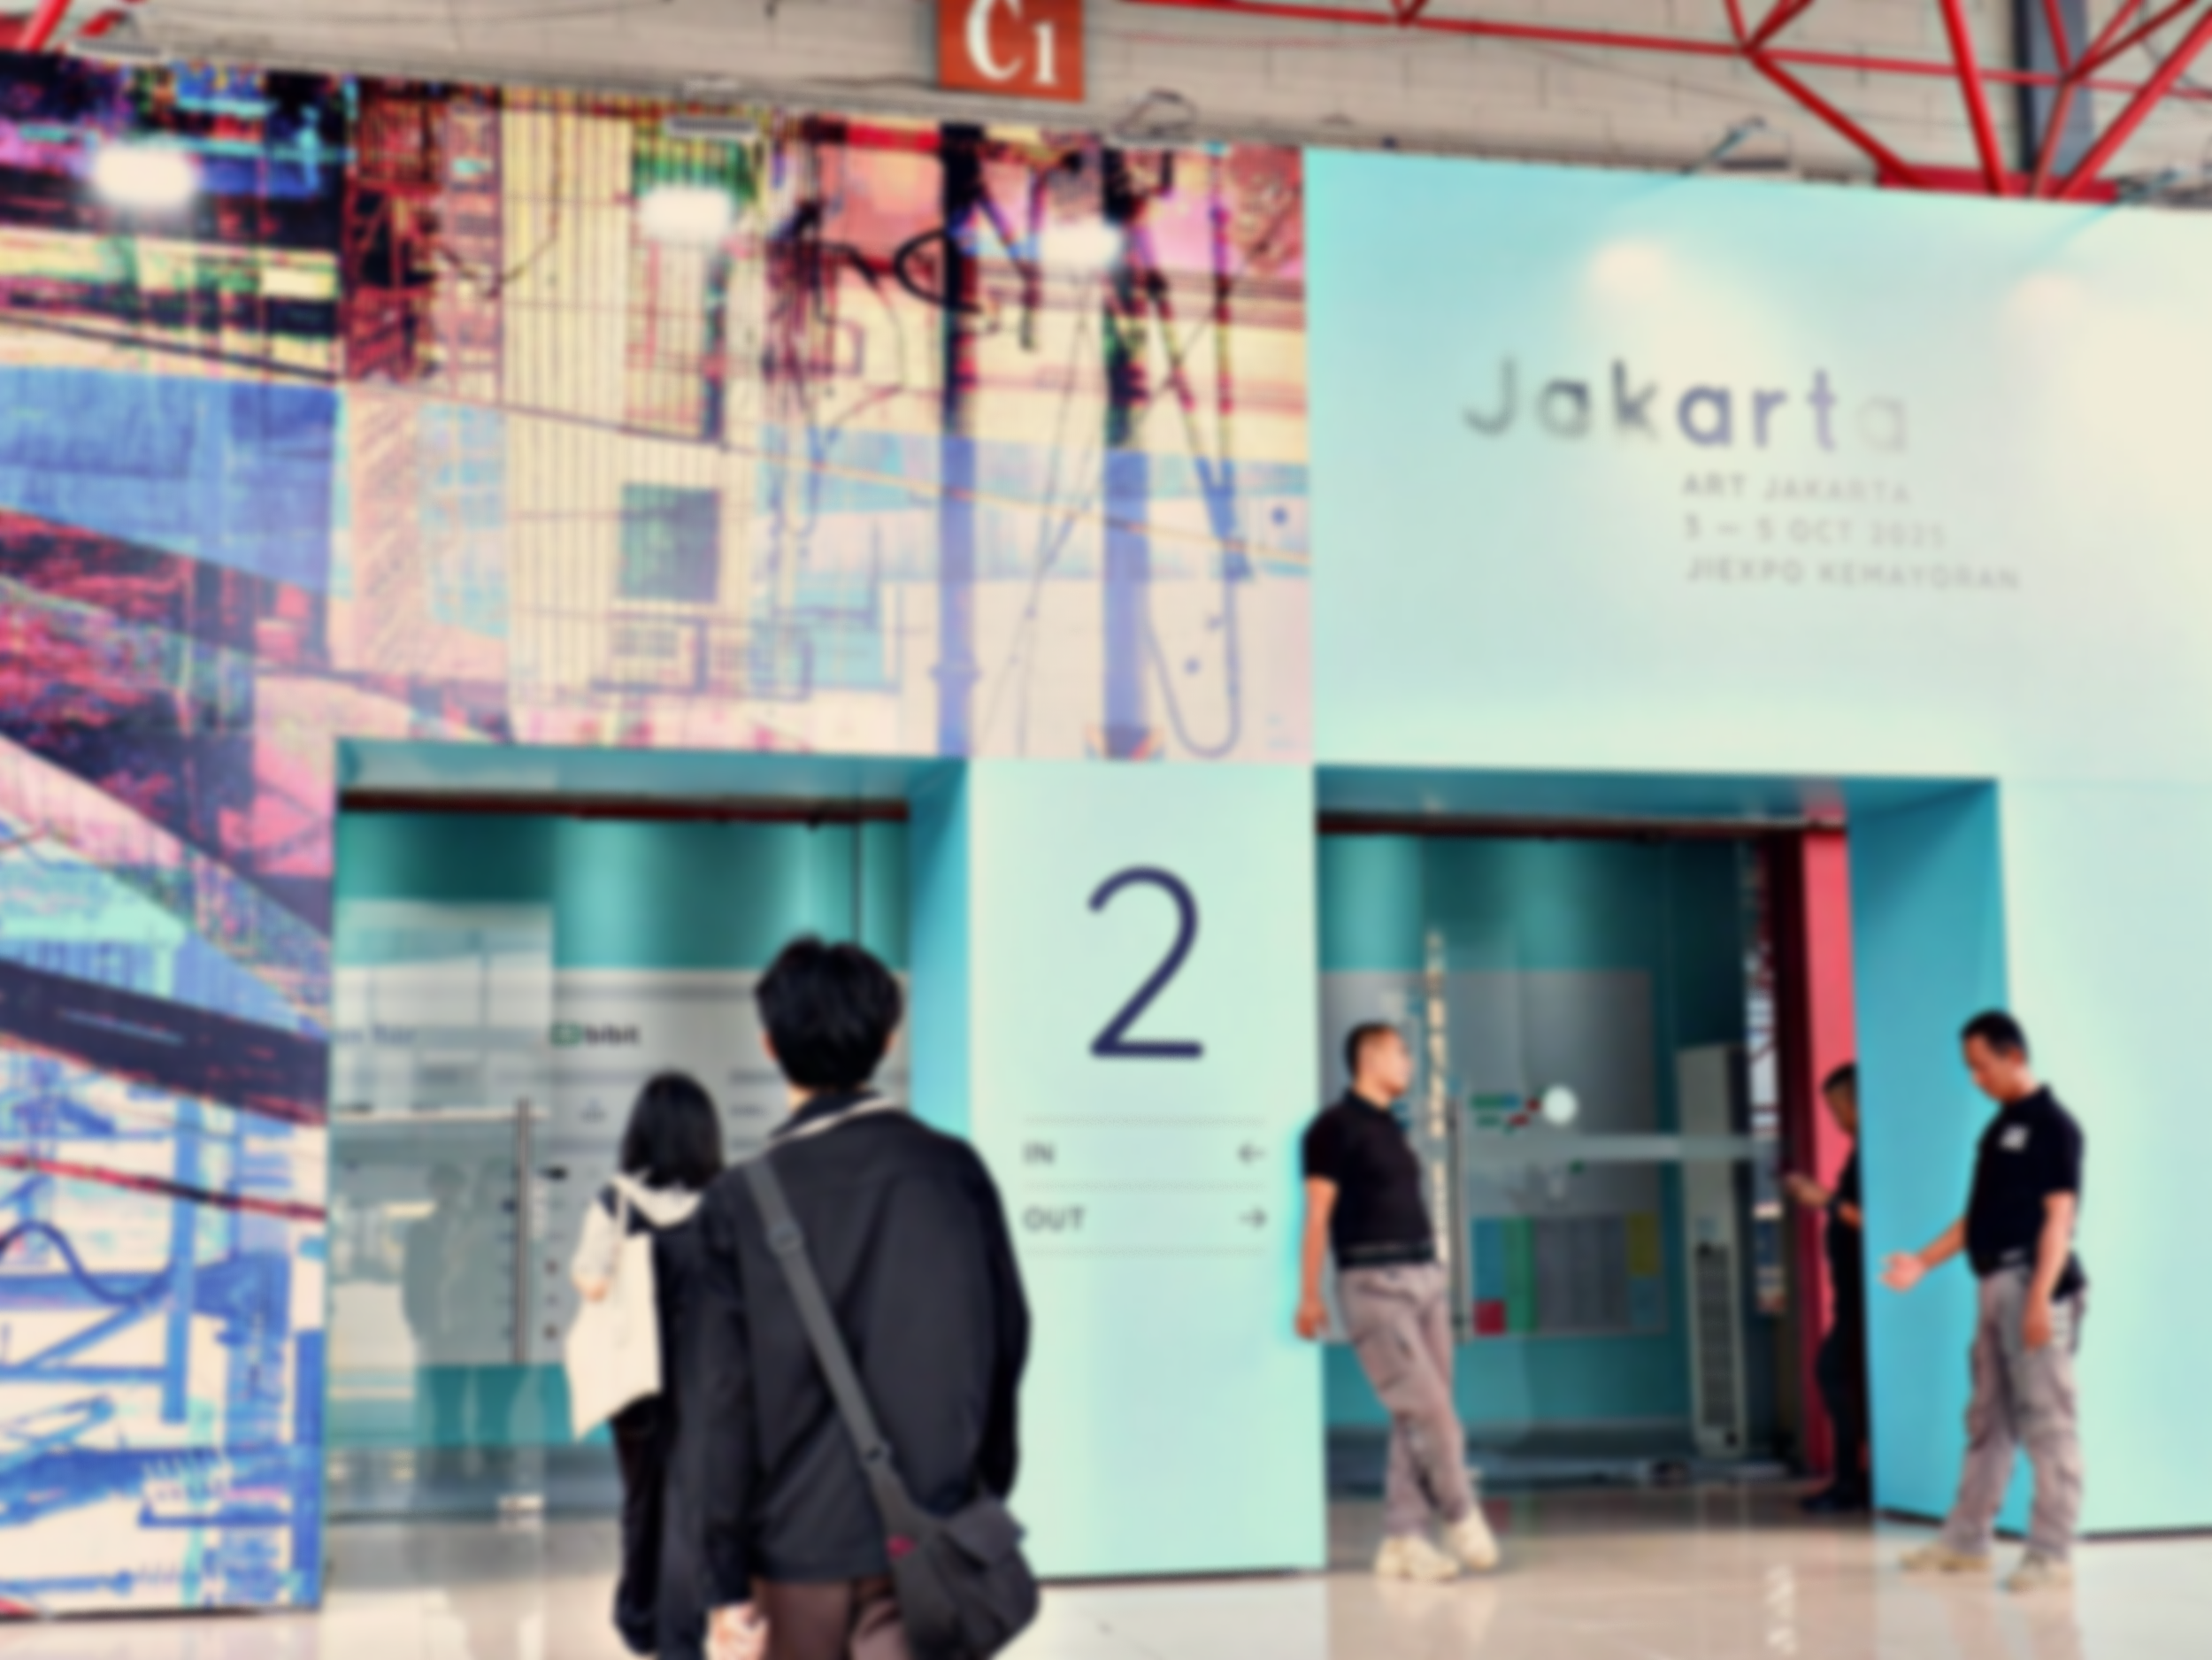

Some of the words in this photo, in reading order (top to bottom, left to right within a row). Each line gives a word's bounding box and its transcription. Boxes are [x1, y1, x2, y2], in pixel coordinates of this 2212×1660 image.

[1462, 355, 1908, 452] Jakarta
[1683, 473, 1747, 496] ART
[1763, 476, 1910, 503] JAKARTA
[1788, 518, 1852, 544] OCT
[1870, 521, 1946, 548] 2025
[1686, 557, 1805, 584] JIEXPO
[1819, 562, 2020, 590] KEMAYORAN
[1087, 866, 1204, 1060] 2
[1023, 1141, 1056, 1165] IN
[1023, 1205, 1086, 1232] OUT
